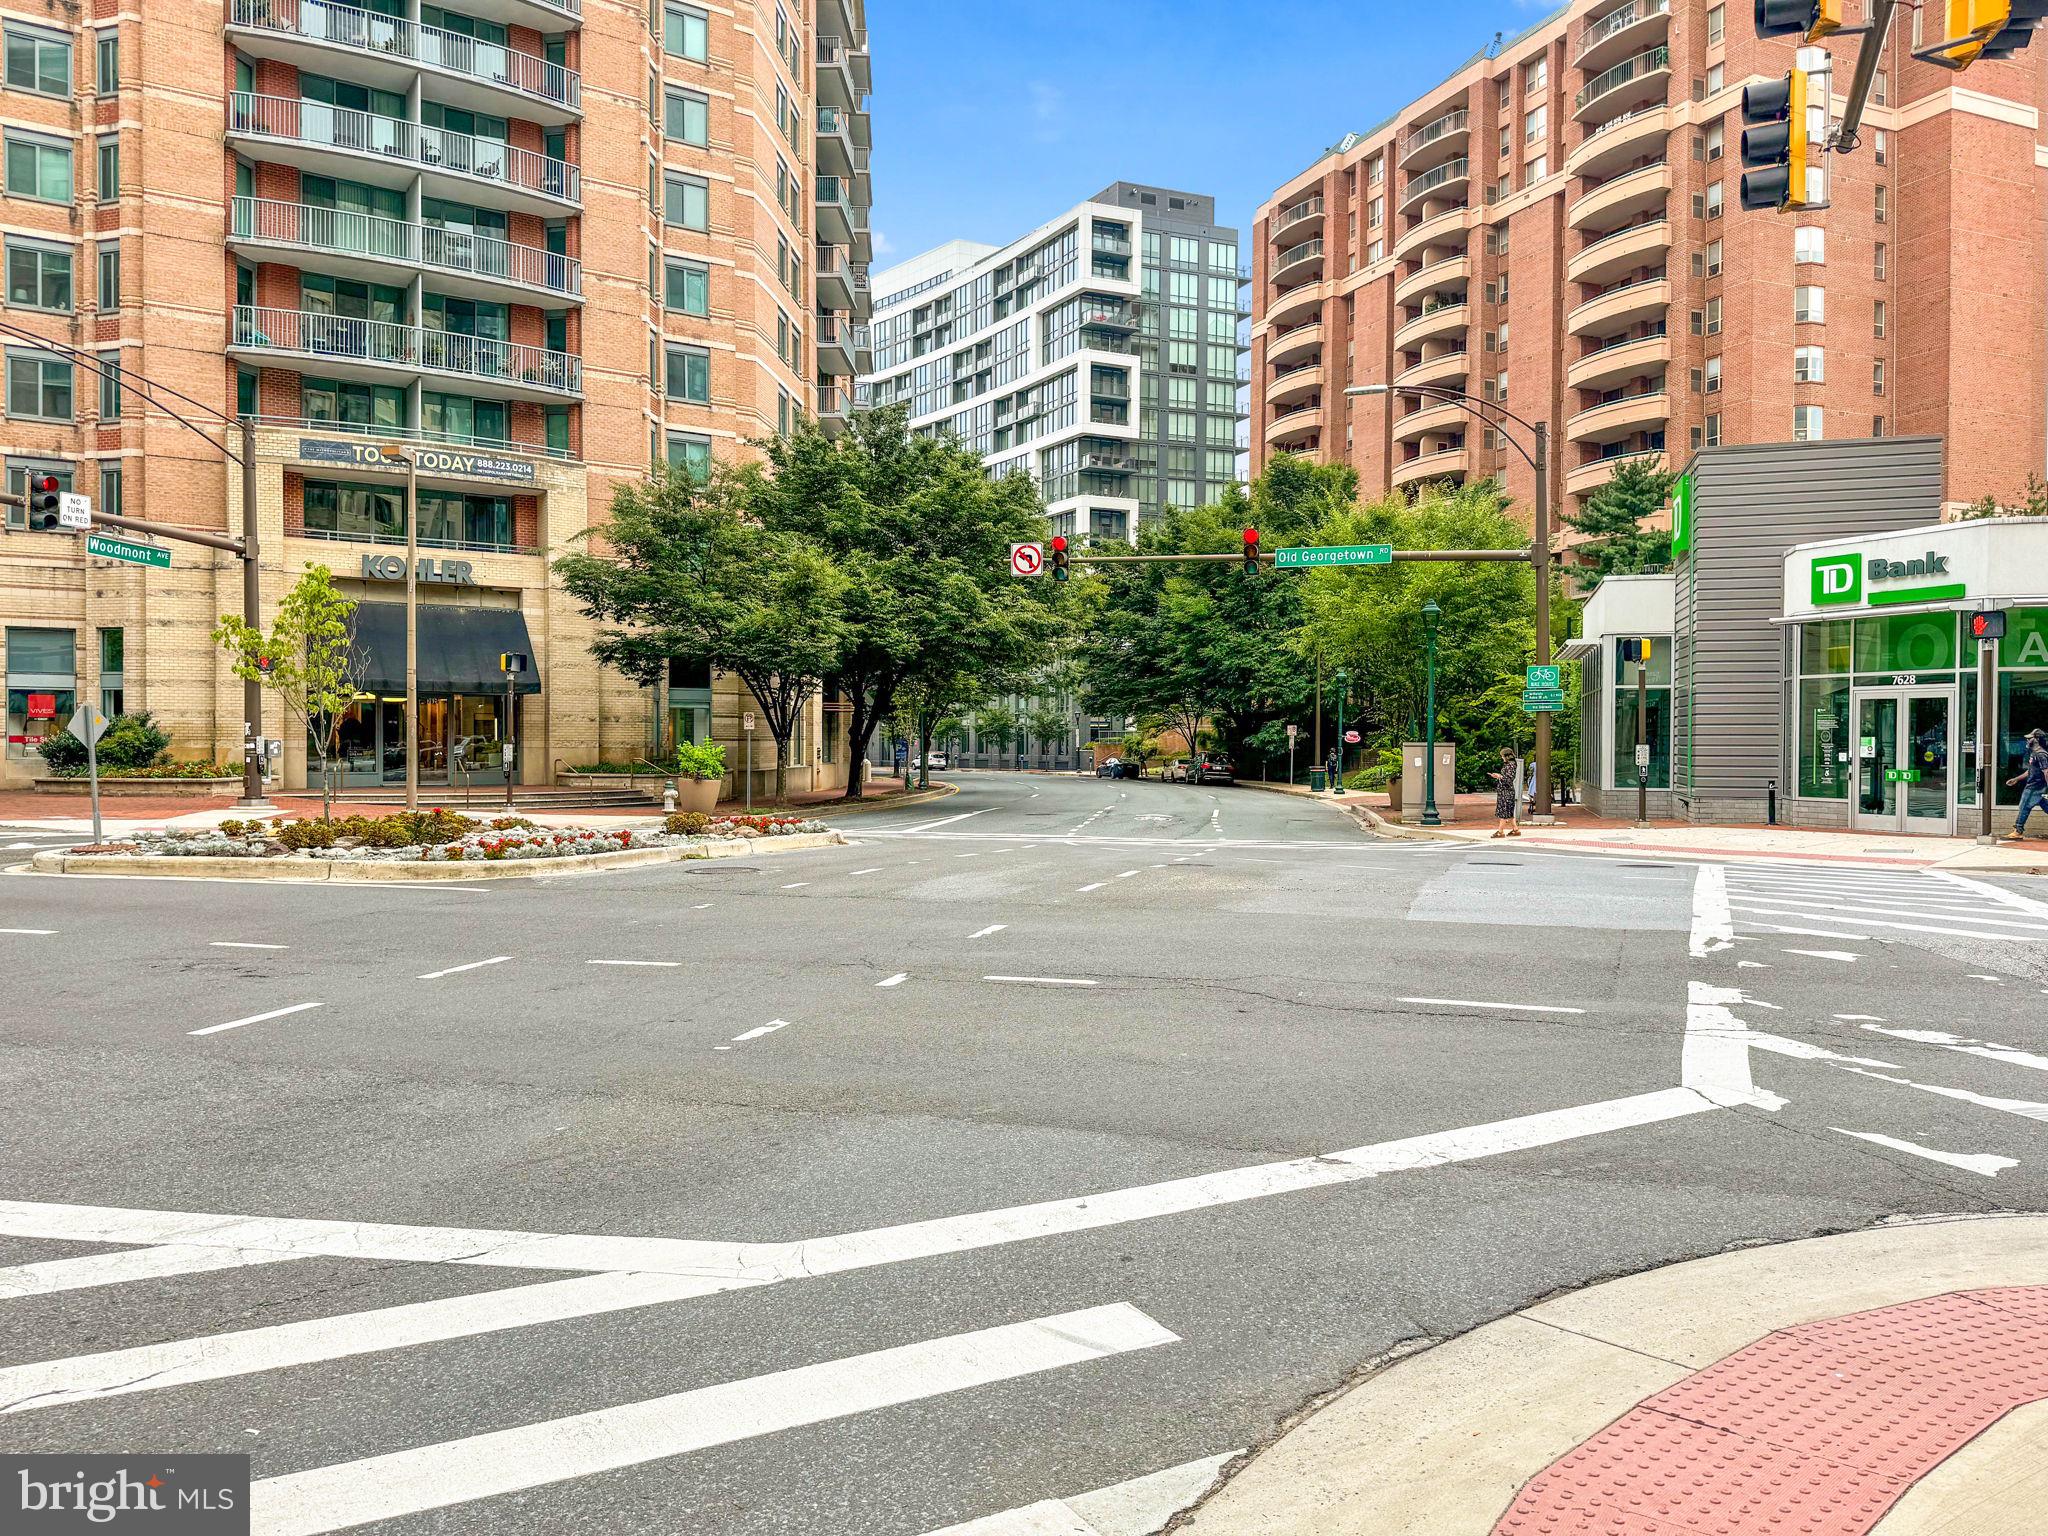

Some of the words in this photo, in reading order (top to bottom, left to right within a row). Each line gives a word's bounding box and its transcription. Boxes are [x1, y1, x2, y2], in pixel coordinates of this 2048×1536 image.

[413, 451, 474, 472] TODAY
[477, 459, 532, 473] 888.223.0214
[67, 506, 85, 514] TURN
[75, 516, 88, 524] RED
[89, 538, 151, 561] Woodmont
[157, 552, 169, 560] AVE
[1279, 552, 1297, 562] Old
[1302, 550, 1374, 563] Georgetown
[1816, 564, 1853, 594] TD
[1868, 551, 1949, 581] Bank
[1892, 675, 1917, 685] 7628
